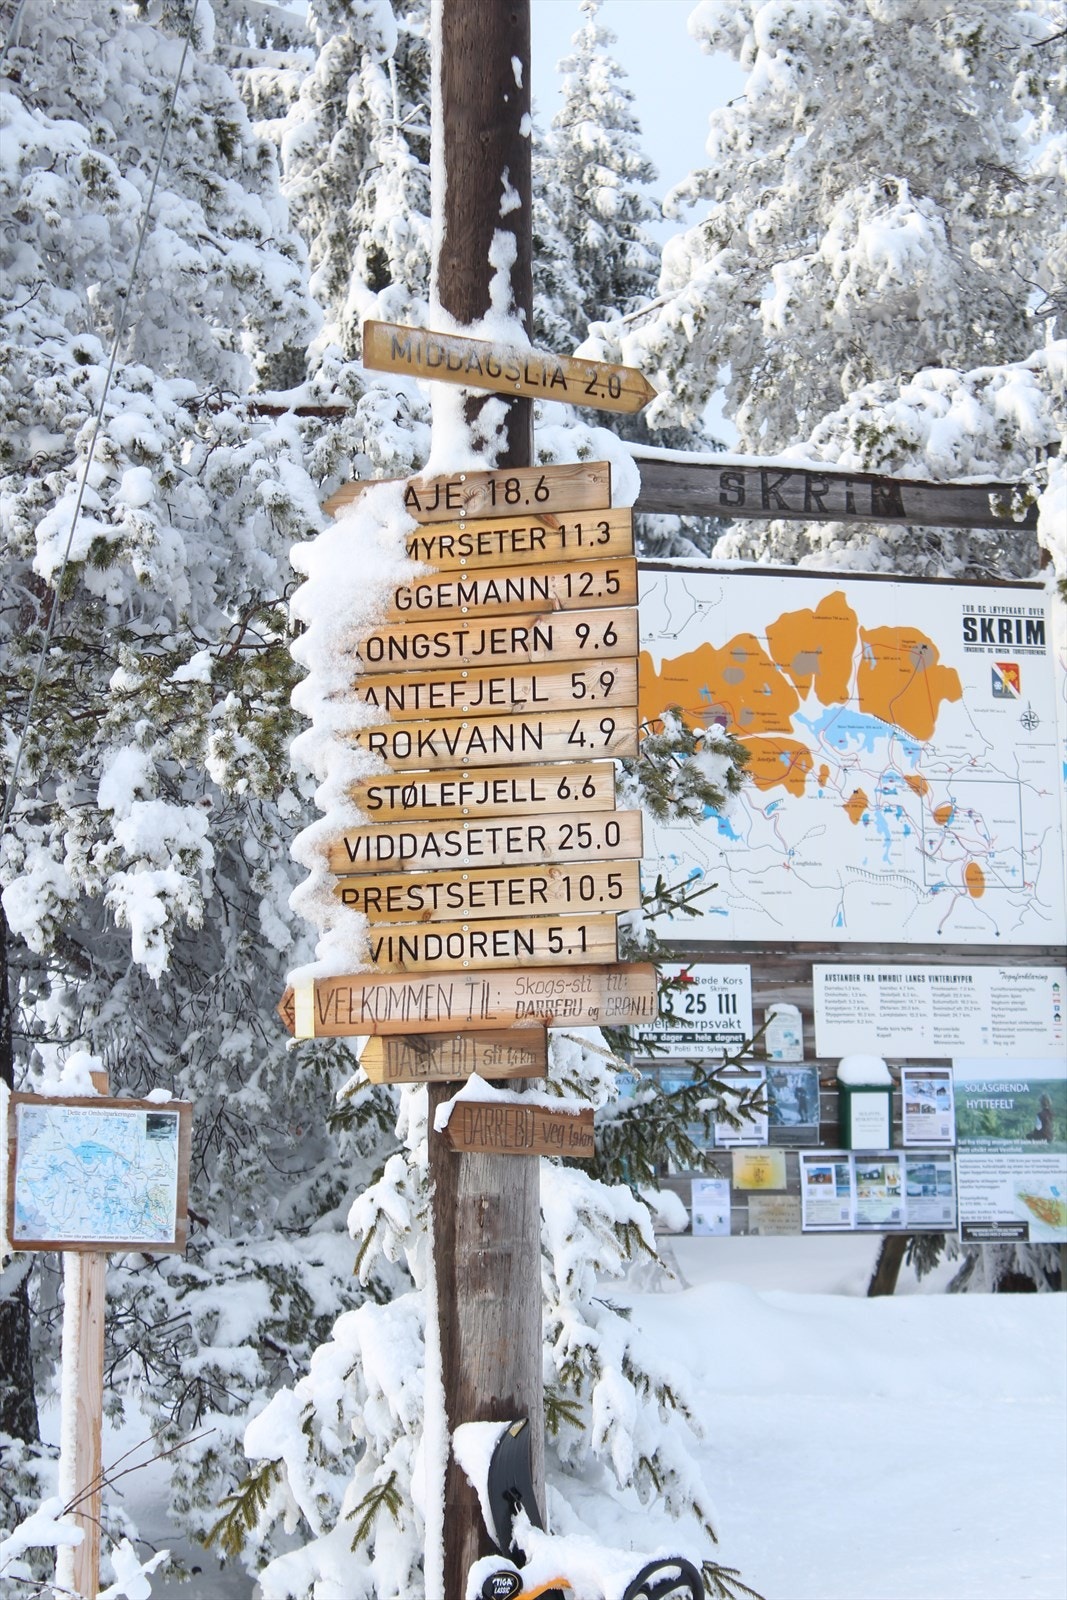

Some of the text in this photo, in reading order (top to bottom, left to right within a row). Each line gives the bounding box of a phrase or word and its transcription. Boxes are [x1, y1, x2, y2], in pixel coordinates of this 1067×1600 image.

[391, 335, 622, 399] MIDDAGSLIA 2.0
[488, 475, 550, 506] 18.6
[558, 521, 610, 548] 11.3
[563, 569, 620, 598] 12.5
[962, 604, 974, 612] TUR
[978, 605, 986, 613] OG
[1028, 607, 1044, 615] OVER
[356, 621, 618, 661] ONGSTJERN 9.6
[963, 616, 1046, 645] SKRIM
[355, 671, 615, 712] ANTEFJELL 5.9
[355, 717, 616, 760] ROKVANN 4.9
[367, 775, 596, 810] STØLEFJELL 6.6
[344, 821, 621, 862] VIDDASETER 25.0
[342, 873, 623, 914] PRESTSETER 10.5
[367, 925, 586, 963] VINDOREN 5.1
[722, 976, 743, 985] Kors
[863, 974, 875, 982] FRA
[905, 974, 926, 983] LANGS
[316, 983, 454, 1025] VELKOMMEN
[515, 998, 583, 1019] DARREBU
[587, 1006, 599, 1021] og
[685, 993, 707, 1014] 25
[718, 993, 737, 1014] 111
[642, 1033, 658, 1041] Alle
[660, 1033, 683, 1043] dager
[695, 1033, 712, 1041] hele
[714, 1033, 743, 1043] døgnet
[387, 1038, 476, 1077] DARREBU
[964, 1082, 1030, 1092] SOLÅSGRENDA
[966, 1099, 1015, 1109] HYTTEFELT
